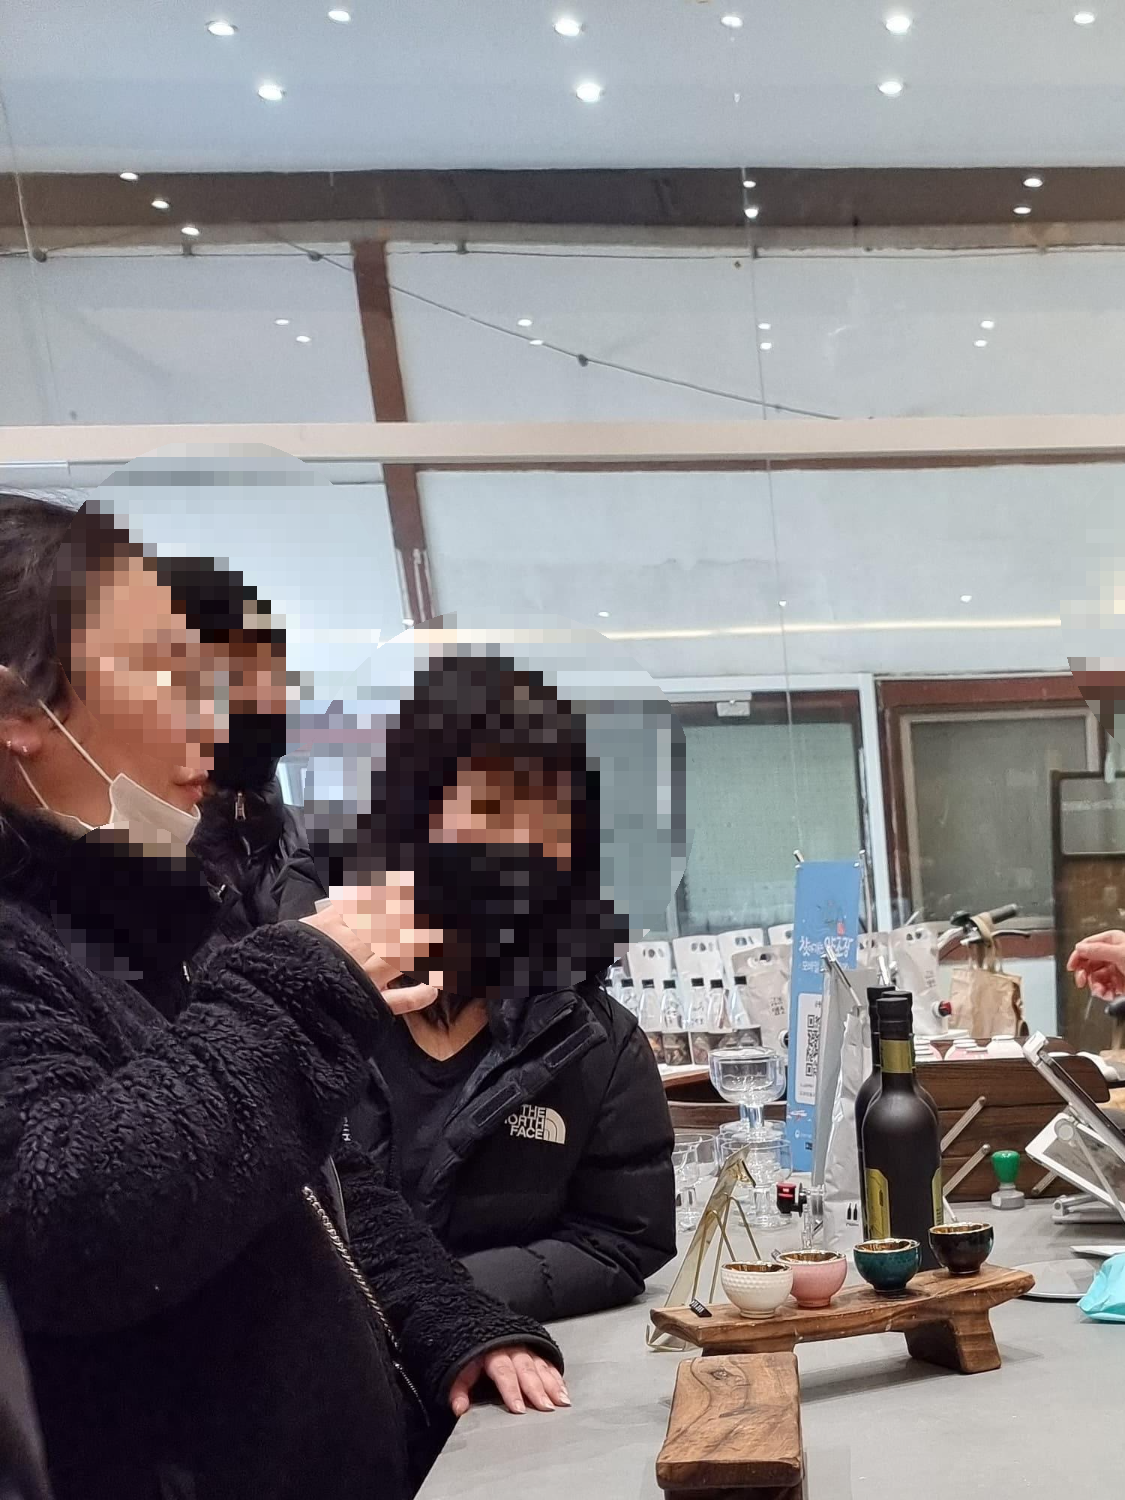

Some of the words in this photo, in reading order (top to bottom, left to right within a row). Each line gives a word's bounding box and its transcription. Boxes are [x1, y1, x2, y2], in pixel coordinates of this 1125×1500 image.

[521, 1103, 546, 1118] THE
[504, 1113, 545, 1131] ORTH
[509, 1124, 544, 1140] FACE
